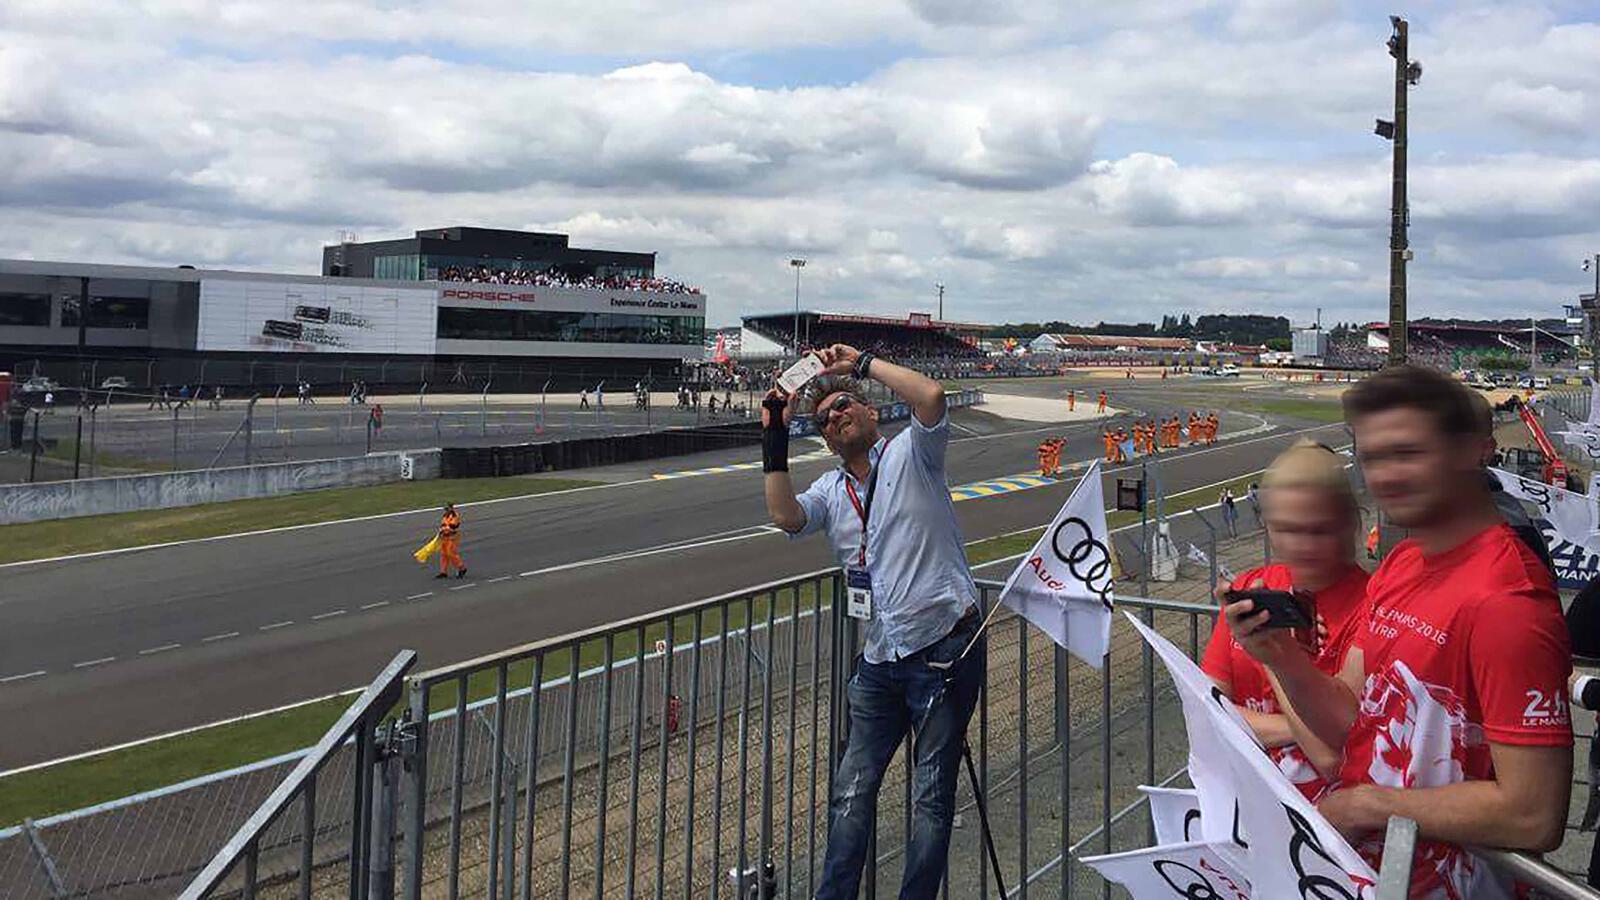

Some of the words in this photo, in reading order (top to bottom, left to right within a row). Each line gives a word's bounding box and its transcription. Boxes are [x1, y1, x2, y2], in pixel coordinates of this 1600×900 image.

[443, 290, 535, 302] PORSCHE
[1029, 556, 1066, 590] Audi
[1555, 567, 1599, 581] MAN
[1415, 621, 1448, 645] 2016
[1522, 717, 1538, 727] LE
